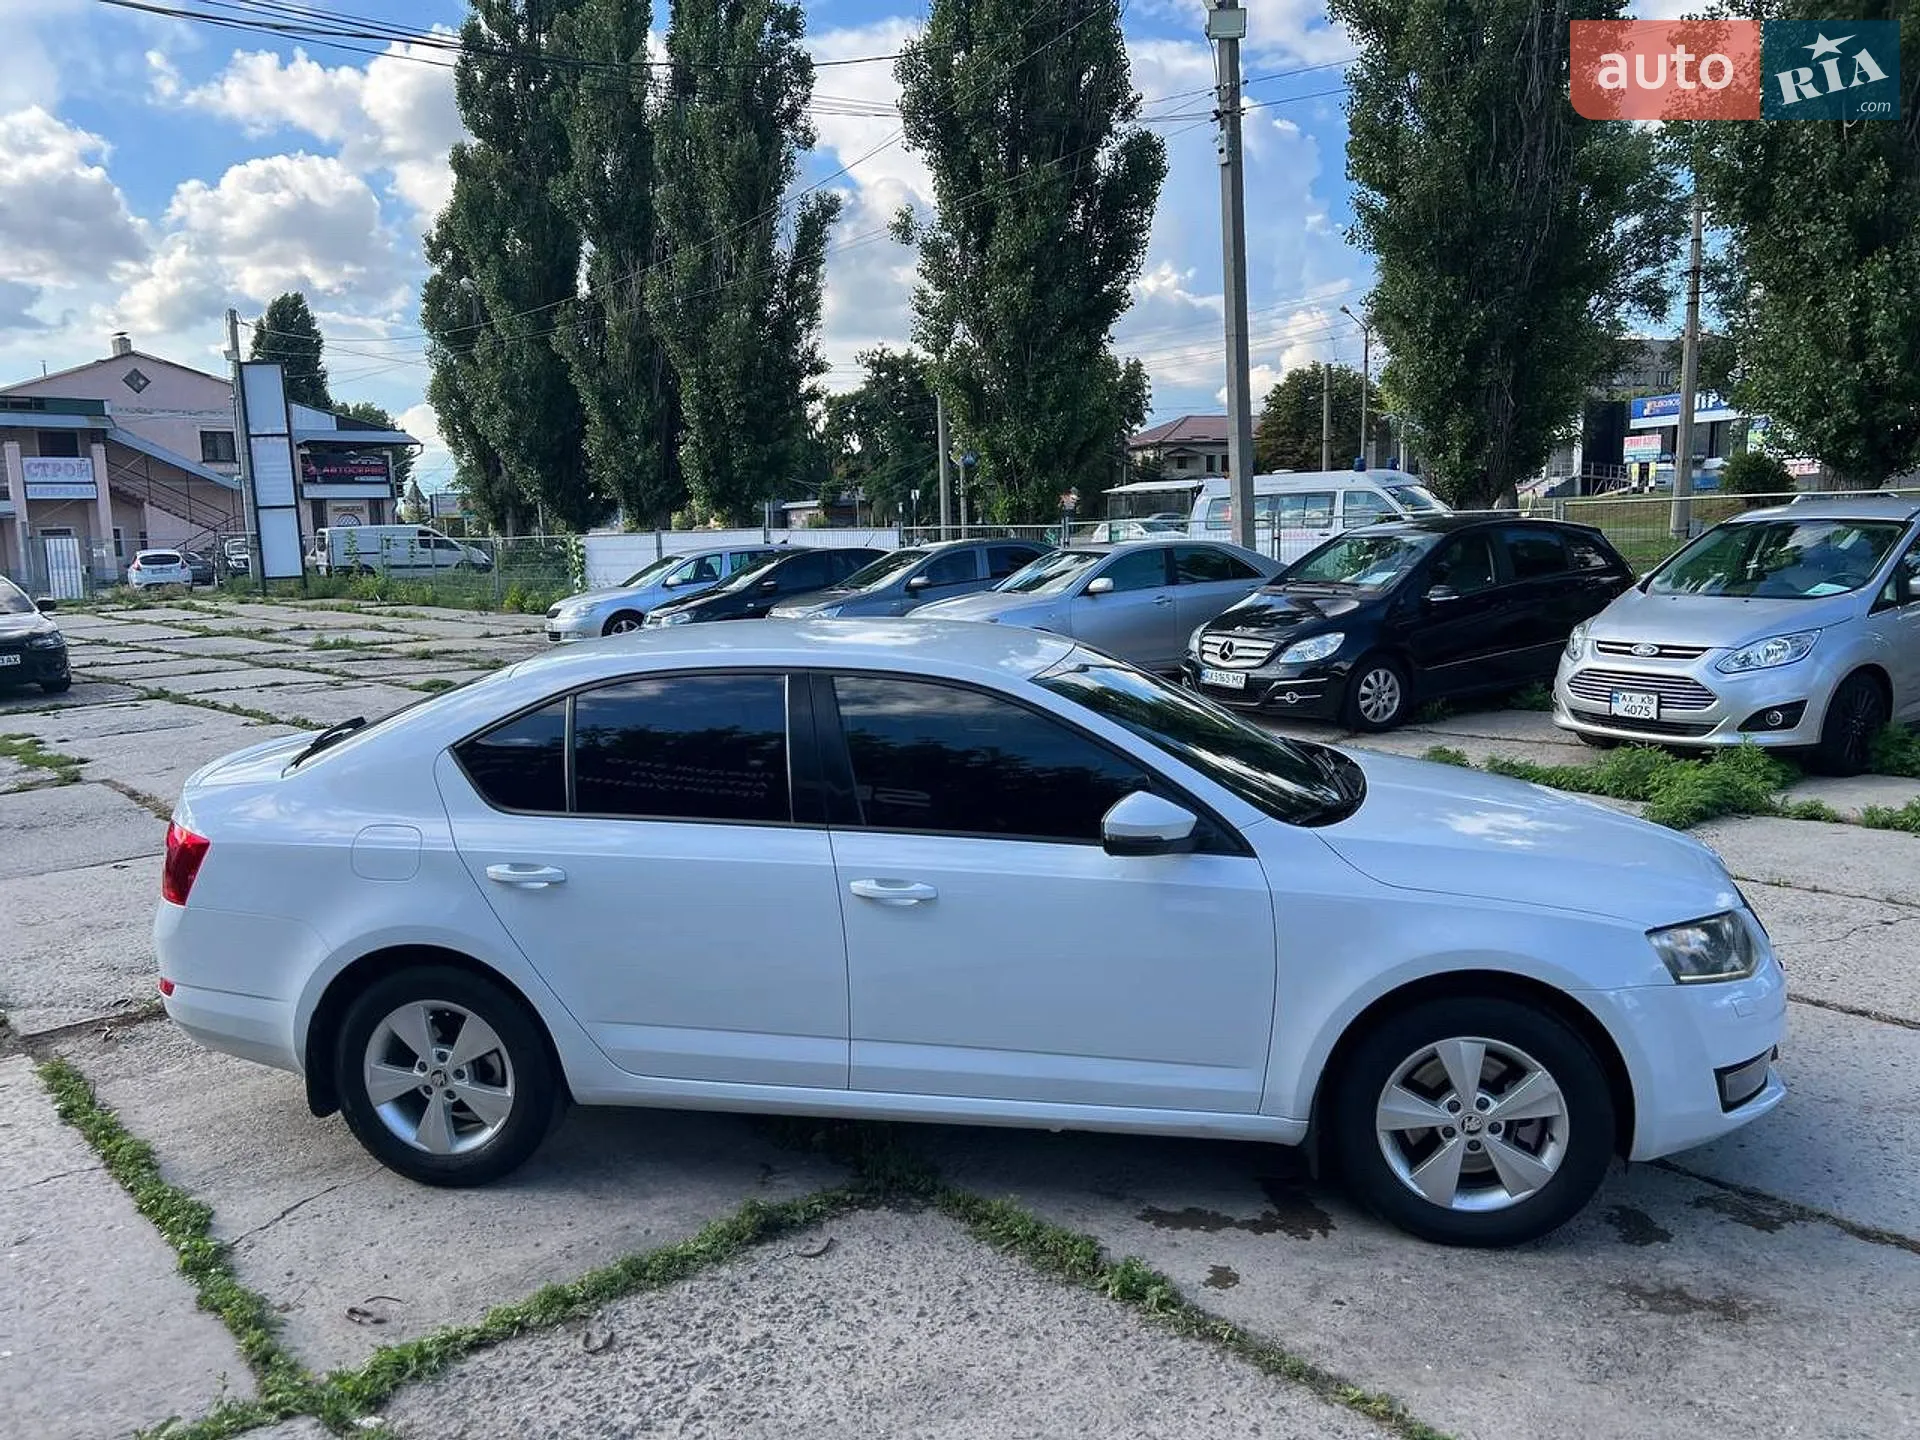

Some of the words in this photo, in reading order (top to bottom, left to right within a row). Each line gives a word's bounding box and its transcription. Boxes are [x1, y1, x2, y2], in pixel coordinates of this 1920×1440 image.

[26, 459, 91, 478] СТРОЙ
[1621, 694, 1635, 703] AX
[1624, 703, 1651, 717] 4075
